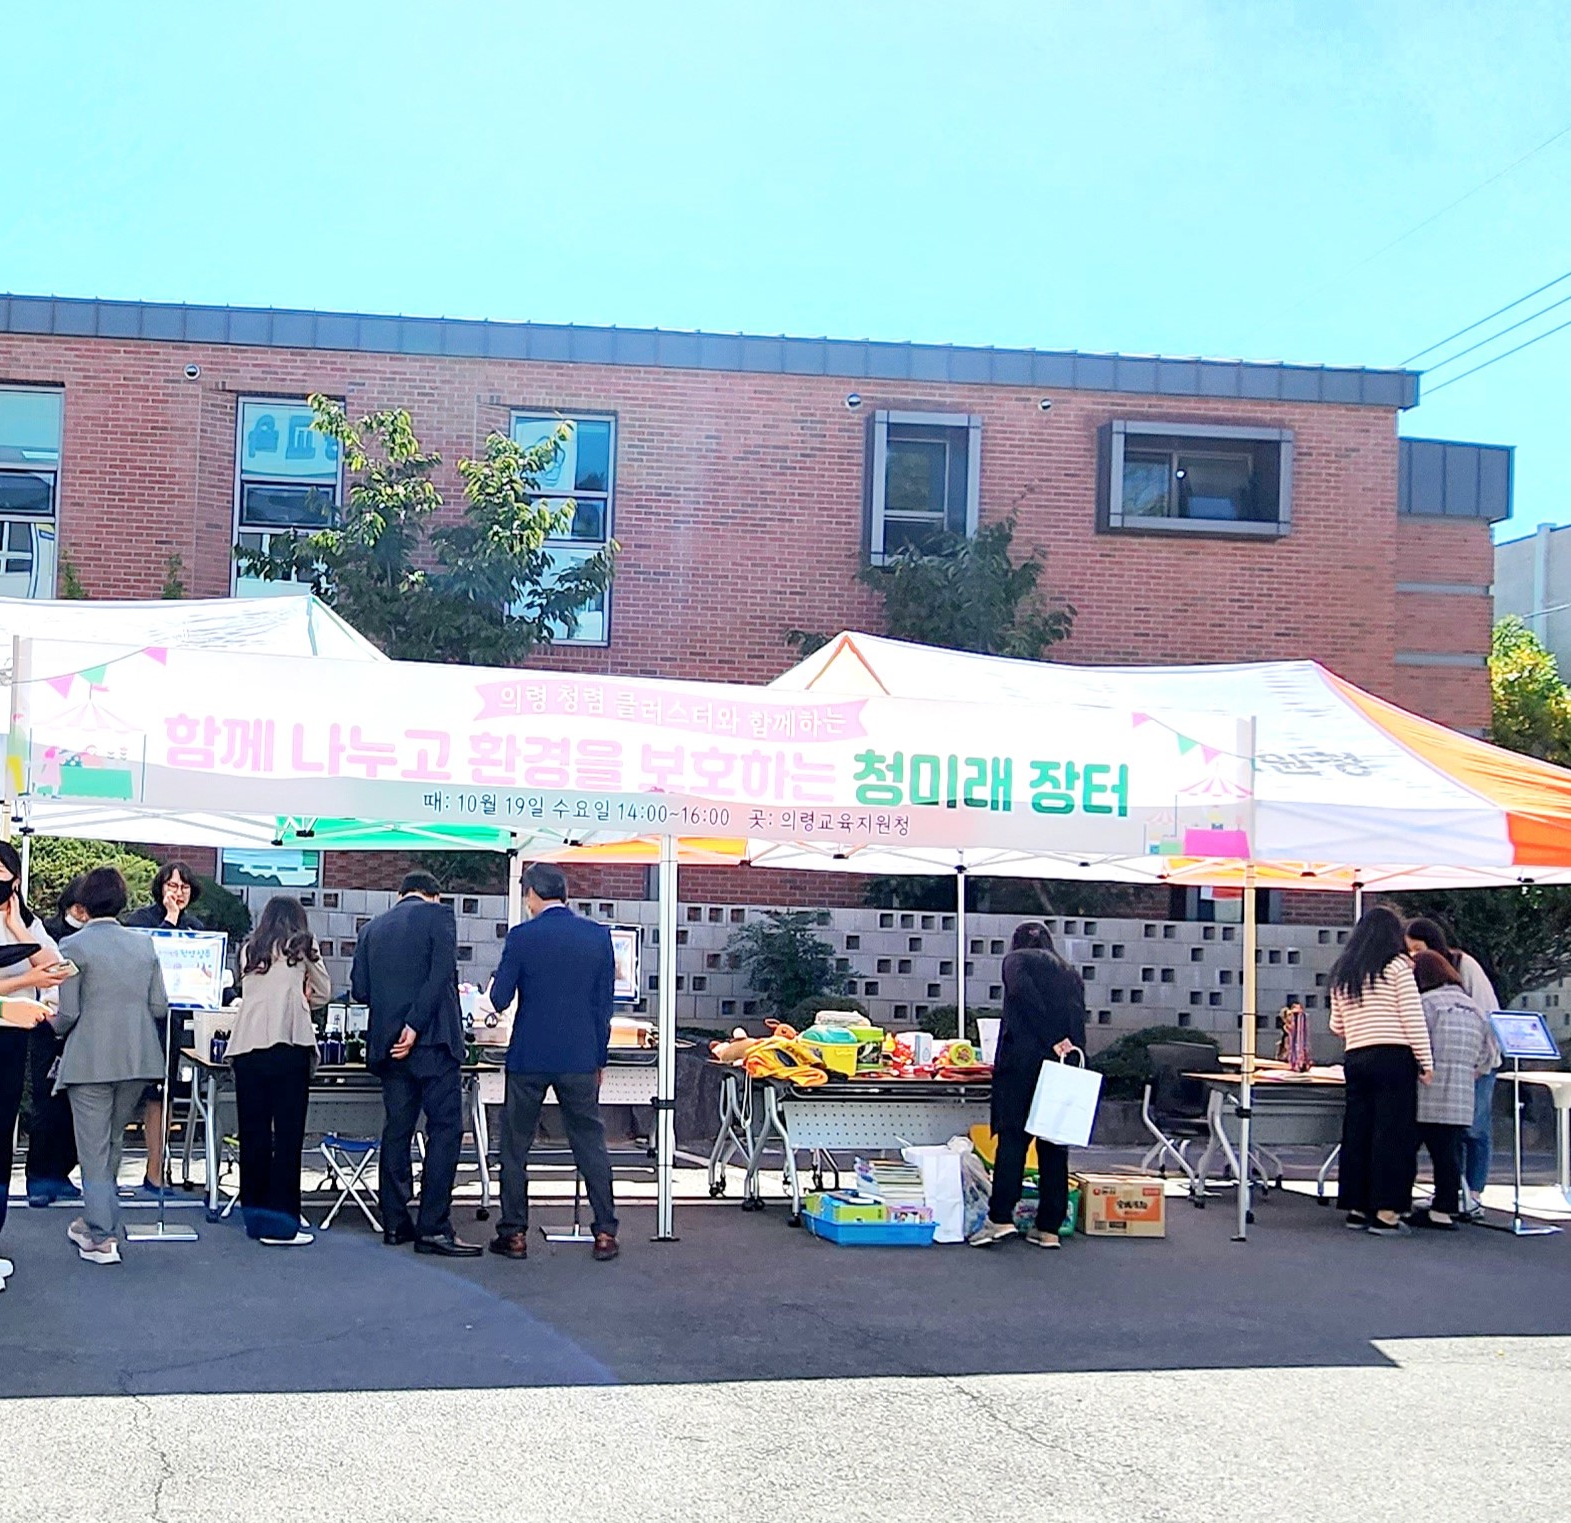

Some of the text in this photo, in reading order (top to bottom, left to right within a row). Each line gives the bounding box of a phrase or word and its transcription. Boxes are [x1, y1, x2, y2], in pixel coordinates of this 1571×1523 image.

[498, 683, 847, 739] 의령 청렴 클러스터와 함께하는
[164, 712, 1129, 819] 함께 나누고 환경을 보호하는 청미래 장터
[423, 790, 911, 837] 때: 10월 19일 수요일 14:00~16:00 곳: 의령교육지원청
